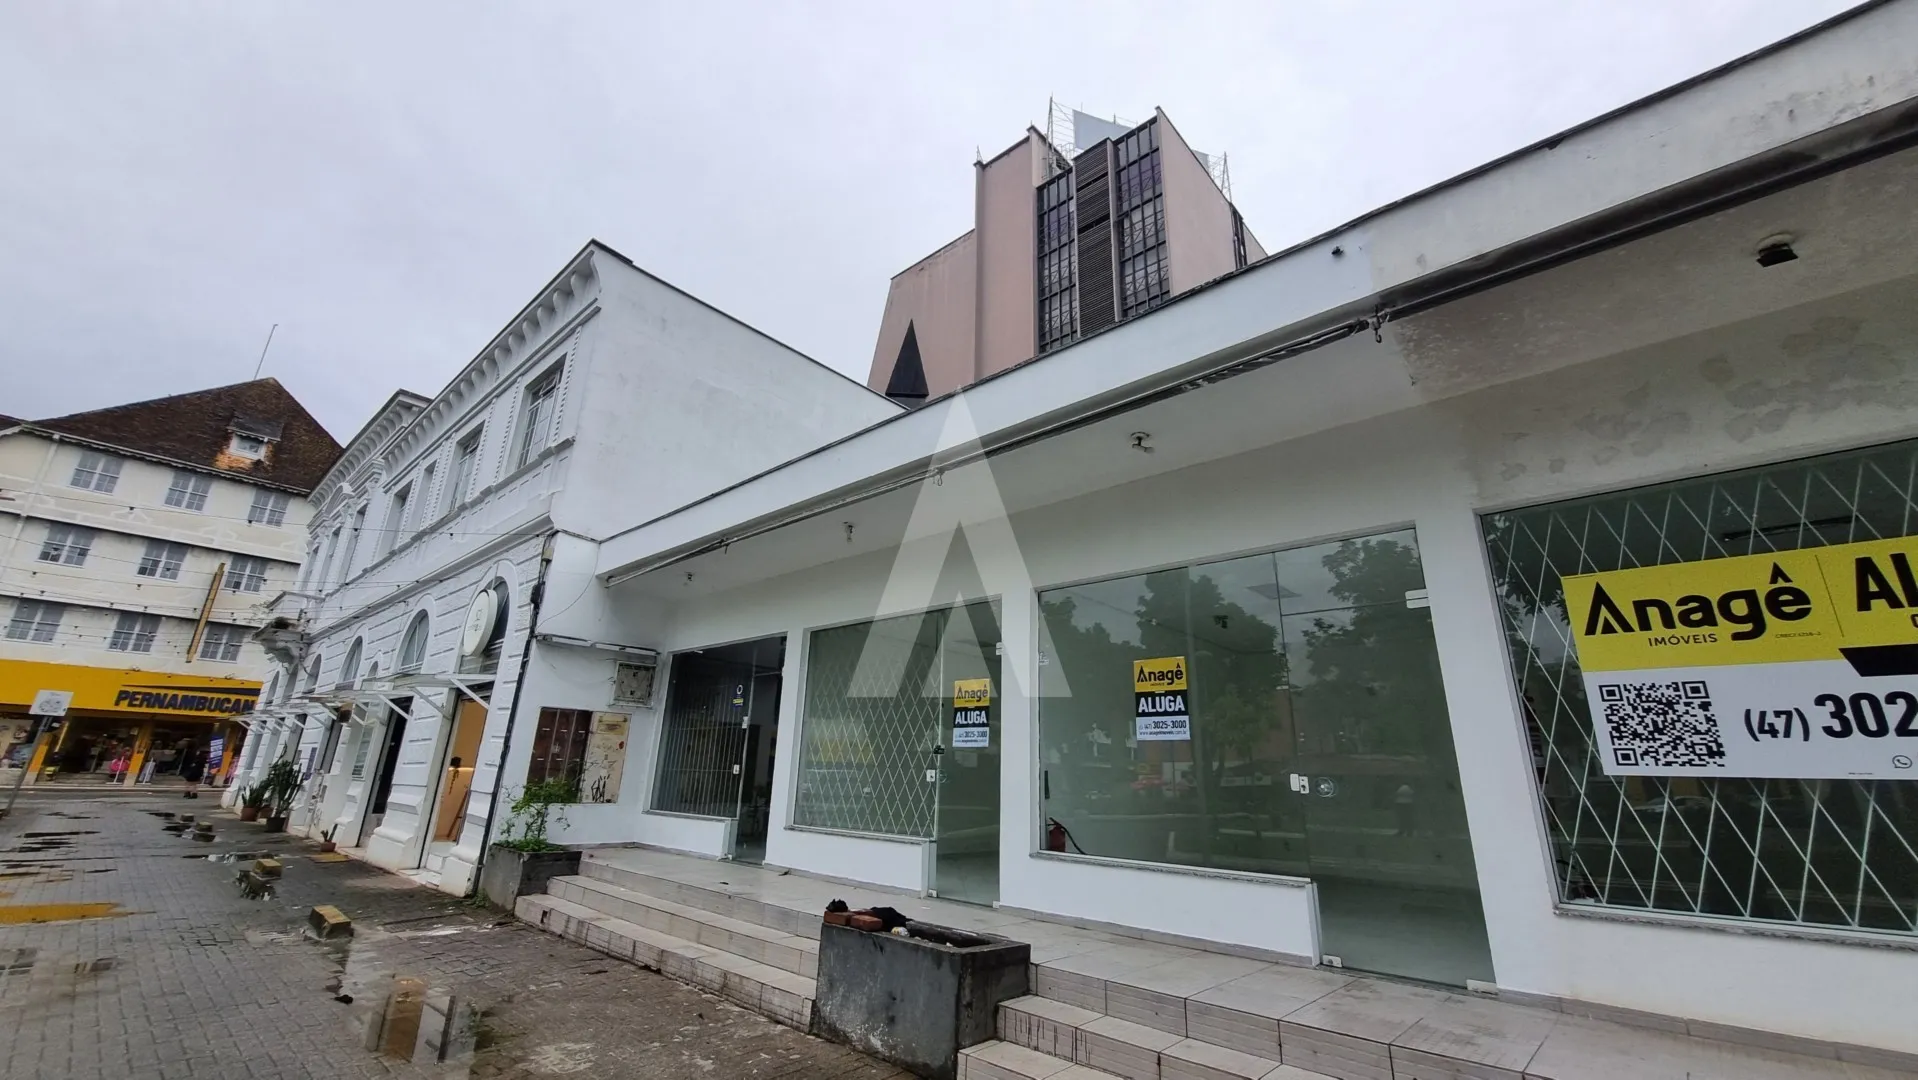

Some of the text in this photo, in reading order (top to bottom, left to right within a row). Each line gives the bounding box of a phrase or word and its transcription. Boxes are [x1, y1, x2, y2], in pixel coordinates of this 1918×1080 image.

[1584, 562, 1812, 641] Anagê
[1648, 633, 1718, 647] IMÓVEIS
[1137, 662, 1184, 686] Anagê
[956, 684, 989, 702] Anagê
[1138, 695, 1186, 713] ALUGA
[955, 710, 988, 725] ALUGA
[1152, 720, 1187, 729] 3025-3000
[1744, 690, 1918, 742] (47) 302
